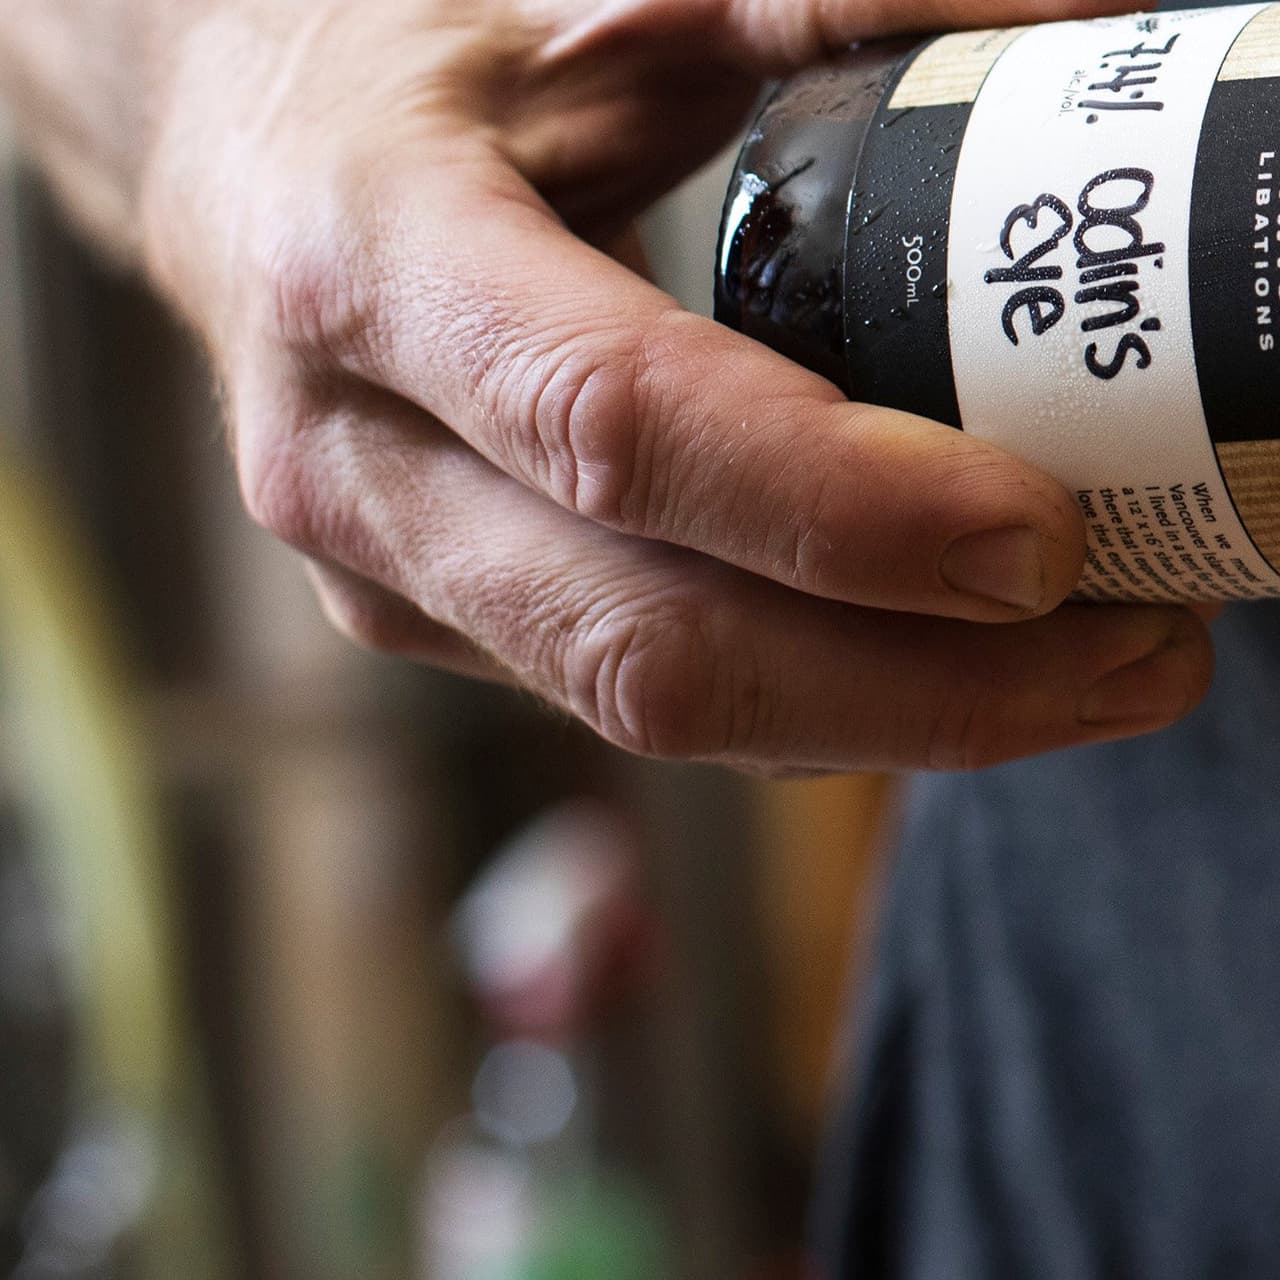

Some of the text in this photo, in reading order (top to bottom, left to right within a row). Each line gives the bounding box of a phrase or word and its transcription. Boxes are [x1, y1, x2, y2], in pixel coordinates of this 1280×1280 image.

[1077, 32, 1181, 125] 7.4%
[902, 235, 924, 308] 500mL
[983, 192, 1074, 347] Eye
[1072, 167, 1166, 380] Odin's
[1254, 150, 1275, 351] LIBATIONS
[1077, 489, 1097, 519] love
[1091, 523, 1114, 548] that
[1099, 488, 1122, 525] there
[1116, 526, 1139, 550] that
[1149, 496, 1177, 527] lived
[1168, 483, 1208, 550] Vancouver
[1192, 482, 1216, 523] When
[1214, 533, 1232, 550] we
